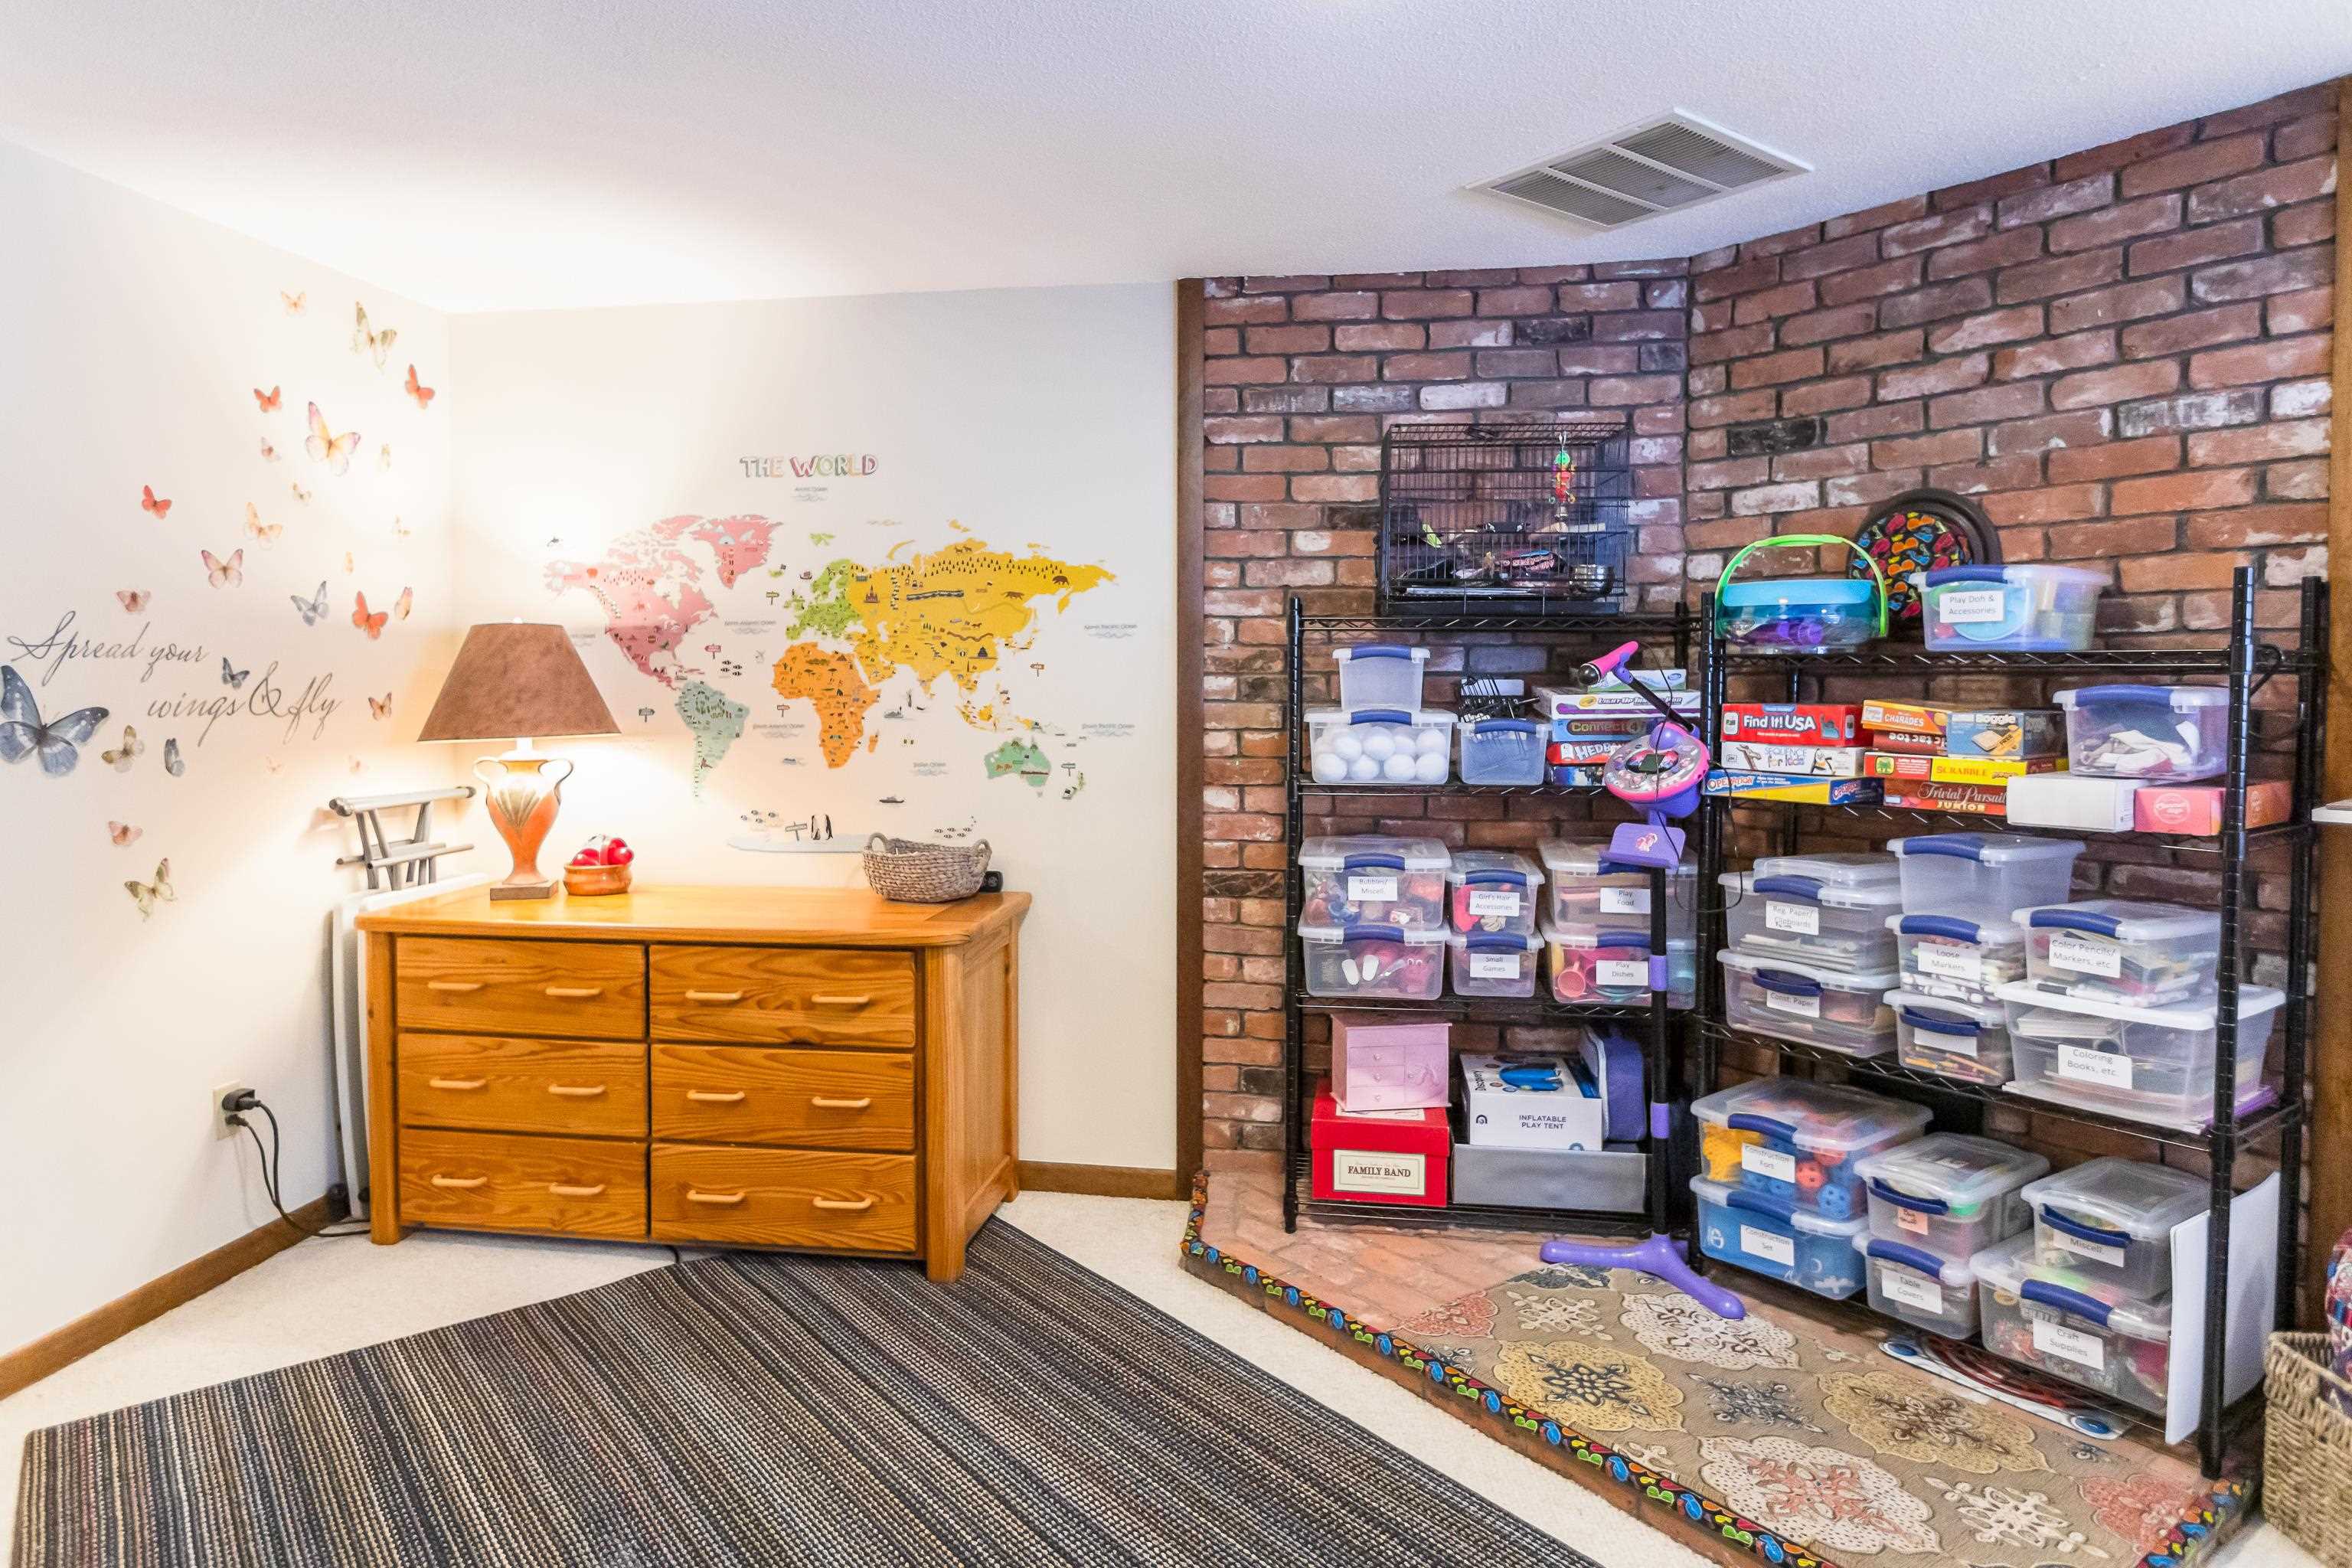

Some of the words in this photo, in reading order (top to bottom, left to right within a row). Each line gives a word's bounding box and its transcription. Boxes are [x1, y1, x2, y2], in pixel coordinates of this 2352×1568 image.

[739, 456, 784, 479] THE
[789, 453, 879, 479] WORLD
[1949, 595, 1967, 604] Play
[1968, 595, 1985, 603] Doh
[1949, 606, 1997, 615] Accessories
[6, 610, 150, 688] Spread
[141, 640, 210, 684] your
[146, 692, 246, 747] wings
[249, 660, 286, 717] &
[282, 672, 341, 746] fly
[1743, 714, 1769, 728] Find
[1771, 714, 1783, 728] It!
[1784, 714, 1817, 731] USA
[1884, 714, 1924, 727] CHARADES
[1571, 721, 1628, 733] Connect
[1888, 733, 1910, 743] toe
[1911, 734, 1932, 745] tac
[1999, 733, 2014, 745] FREE
[1764, 746, 1808, 759] SEQUENCE
[1767, 755, 1783, 768] for
[1935, 765, 1989, 777] SCRABBLE
[1707, 776, 1753, 790] OPERATION
[1917, 782, 1961, 800] Trivial
[1936, 799, 1985, 812] JUNIOR
[1619, 889, 1633, 898] Play
[1475, 903, 1514, 911] Accessories
[1617, 898, 1635, 906] Food
[2052, 939, 2076, 950] Color
[1936, 949, 1960, 959] Loose
[1615, 961, 1630, 970] Play
[1612, 970, 1635, 978] Dishes
[2073, 1048, 2114, 1065] Coloring
[1518, 1114, 1567, 1123] INFLATABLE
[1348, 1165, 1383, 1176] FAMILY
[1383, 1168, 1411, 1178] BAND
